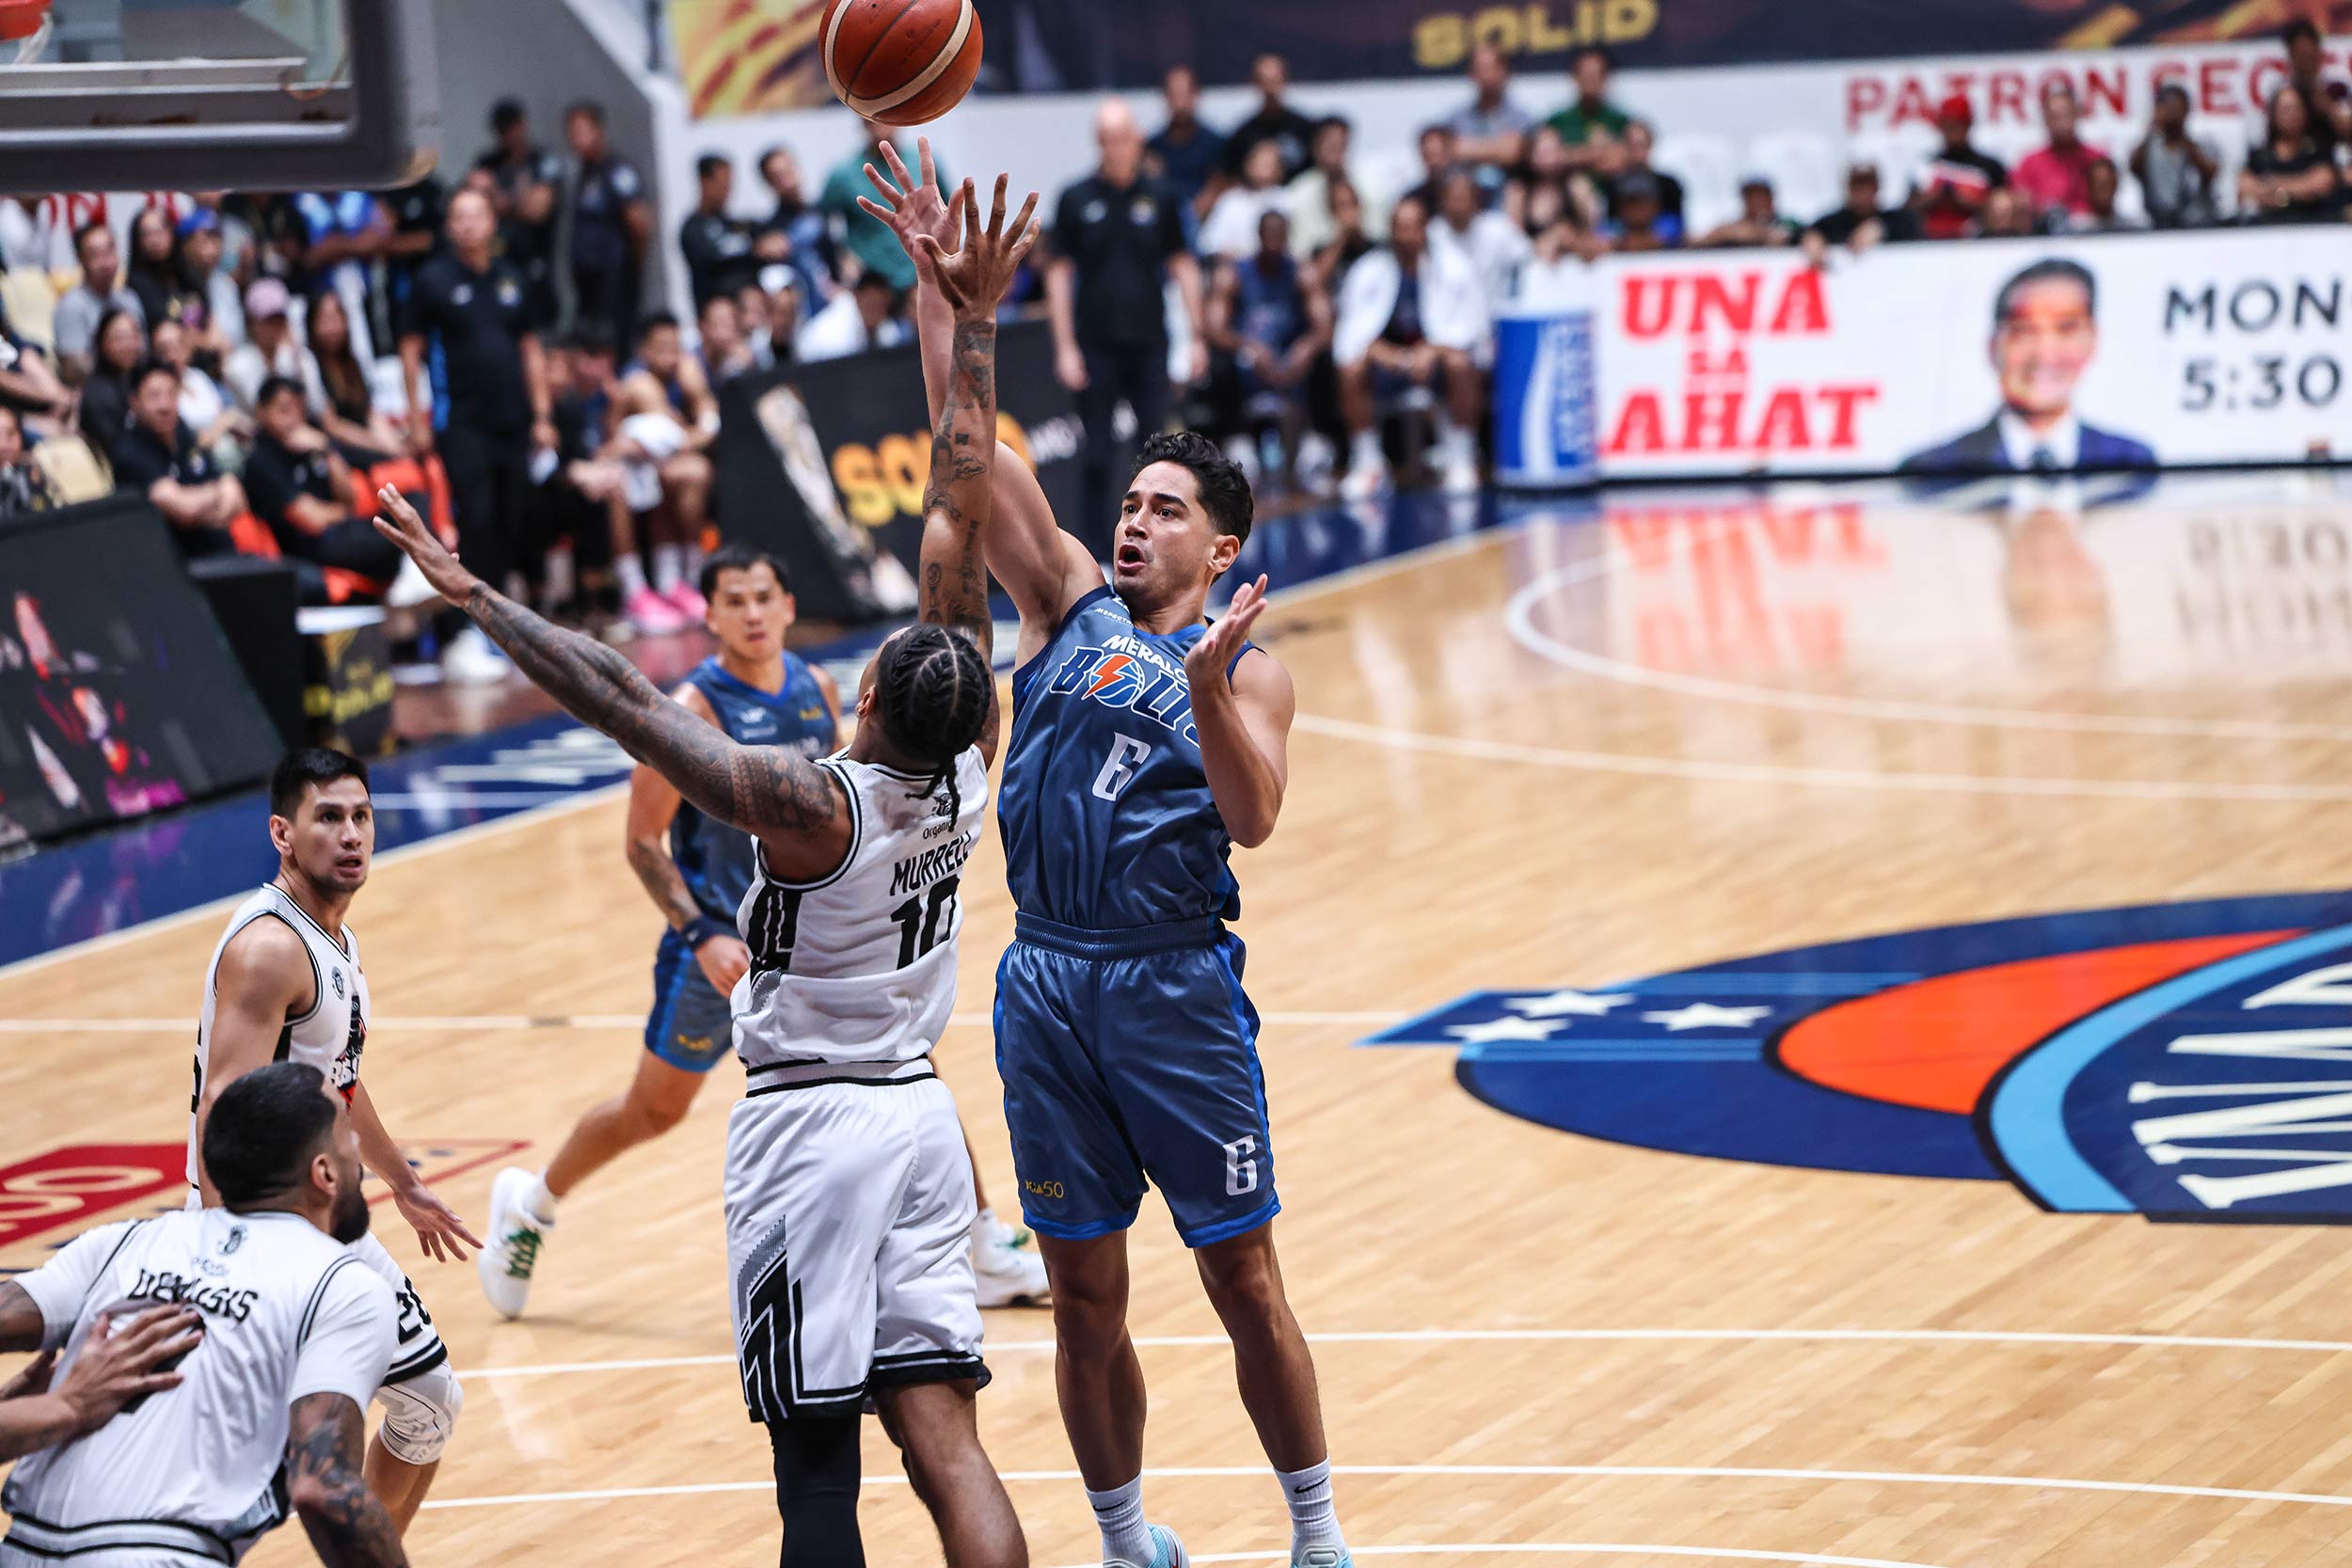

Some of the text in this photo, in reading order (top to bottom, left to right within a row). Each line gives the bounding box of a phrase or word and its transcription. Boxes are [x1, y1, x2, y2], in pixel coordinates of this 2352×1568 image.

[1414, 0, 1657, 68] SOLID
[1622, 267, 1830, 337] UNA
[2165, 279, 2342, 332] MON
[2181, 354, 2342, 411] 5:30
[1597, 387, 1878, 453] AHAT
[1102, 634, 1190, 684] MERALC
[1092, 732, 1152, 801] 6
[890, 831, 973, 897] MURRELL
[890, 874, 961, 970] 10
[1222, 1134, 1259, 1196] 6
